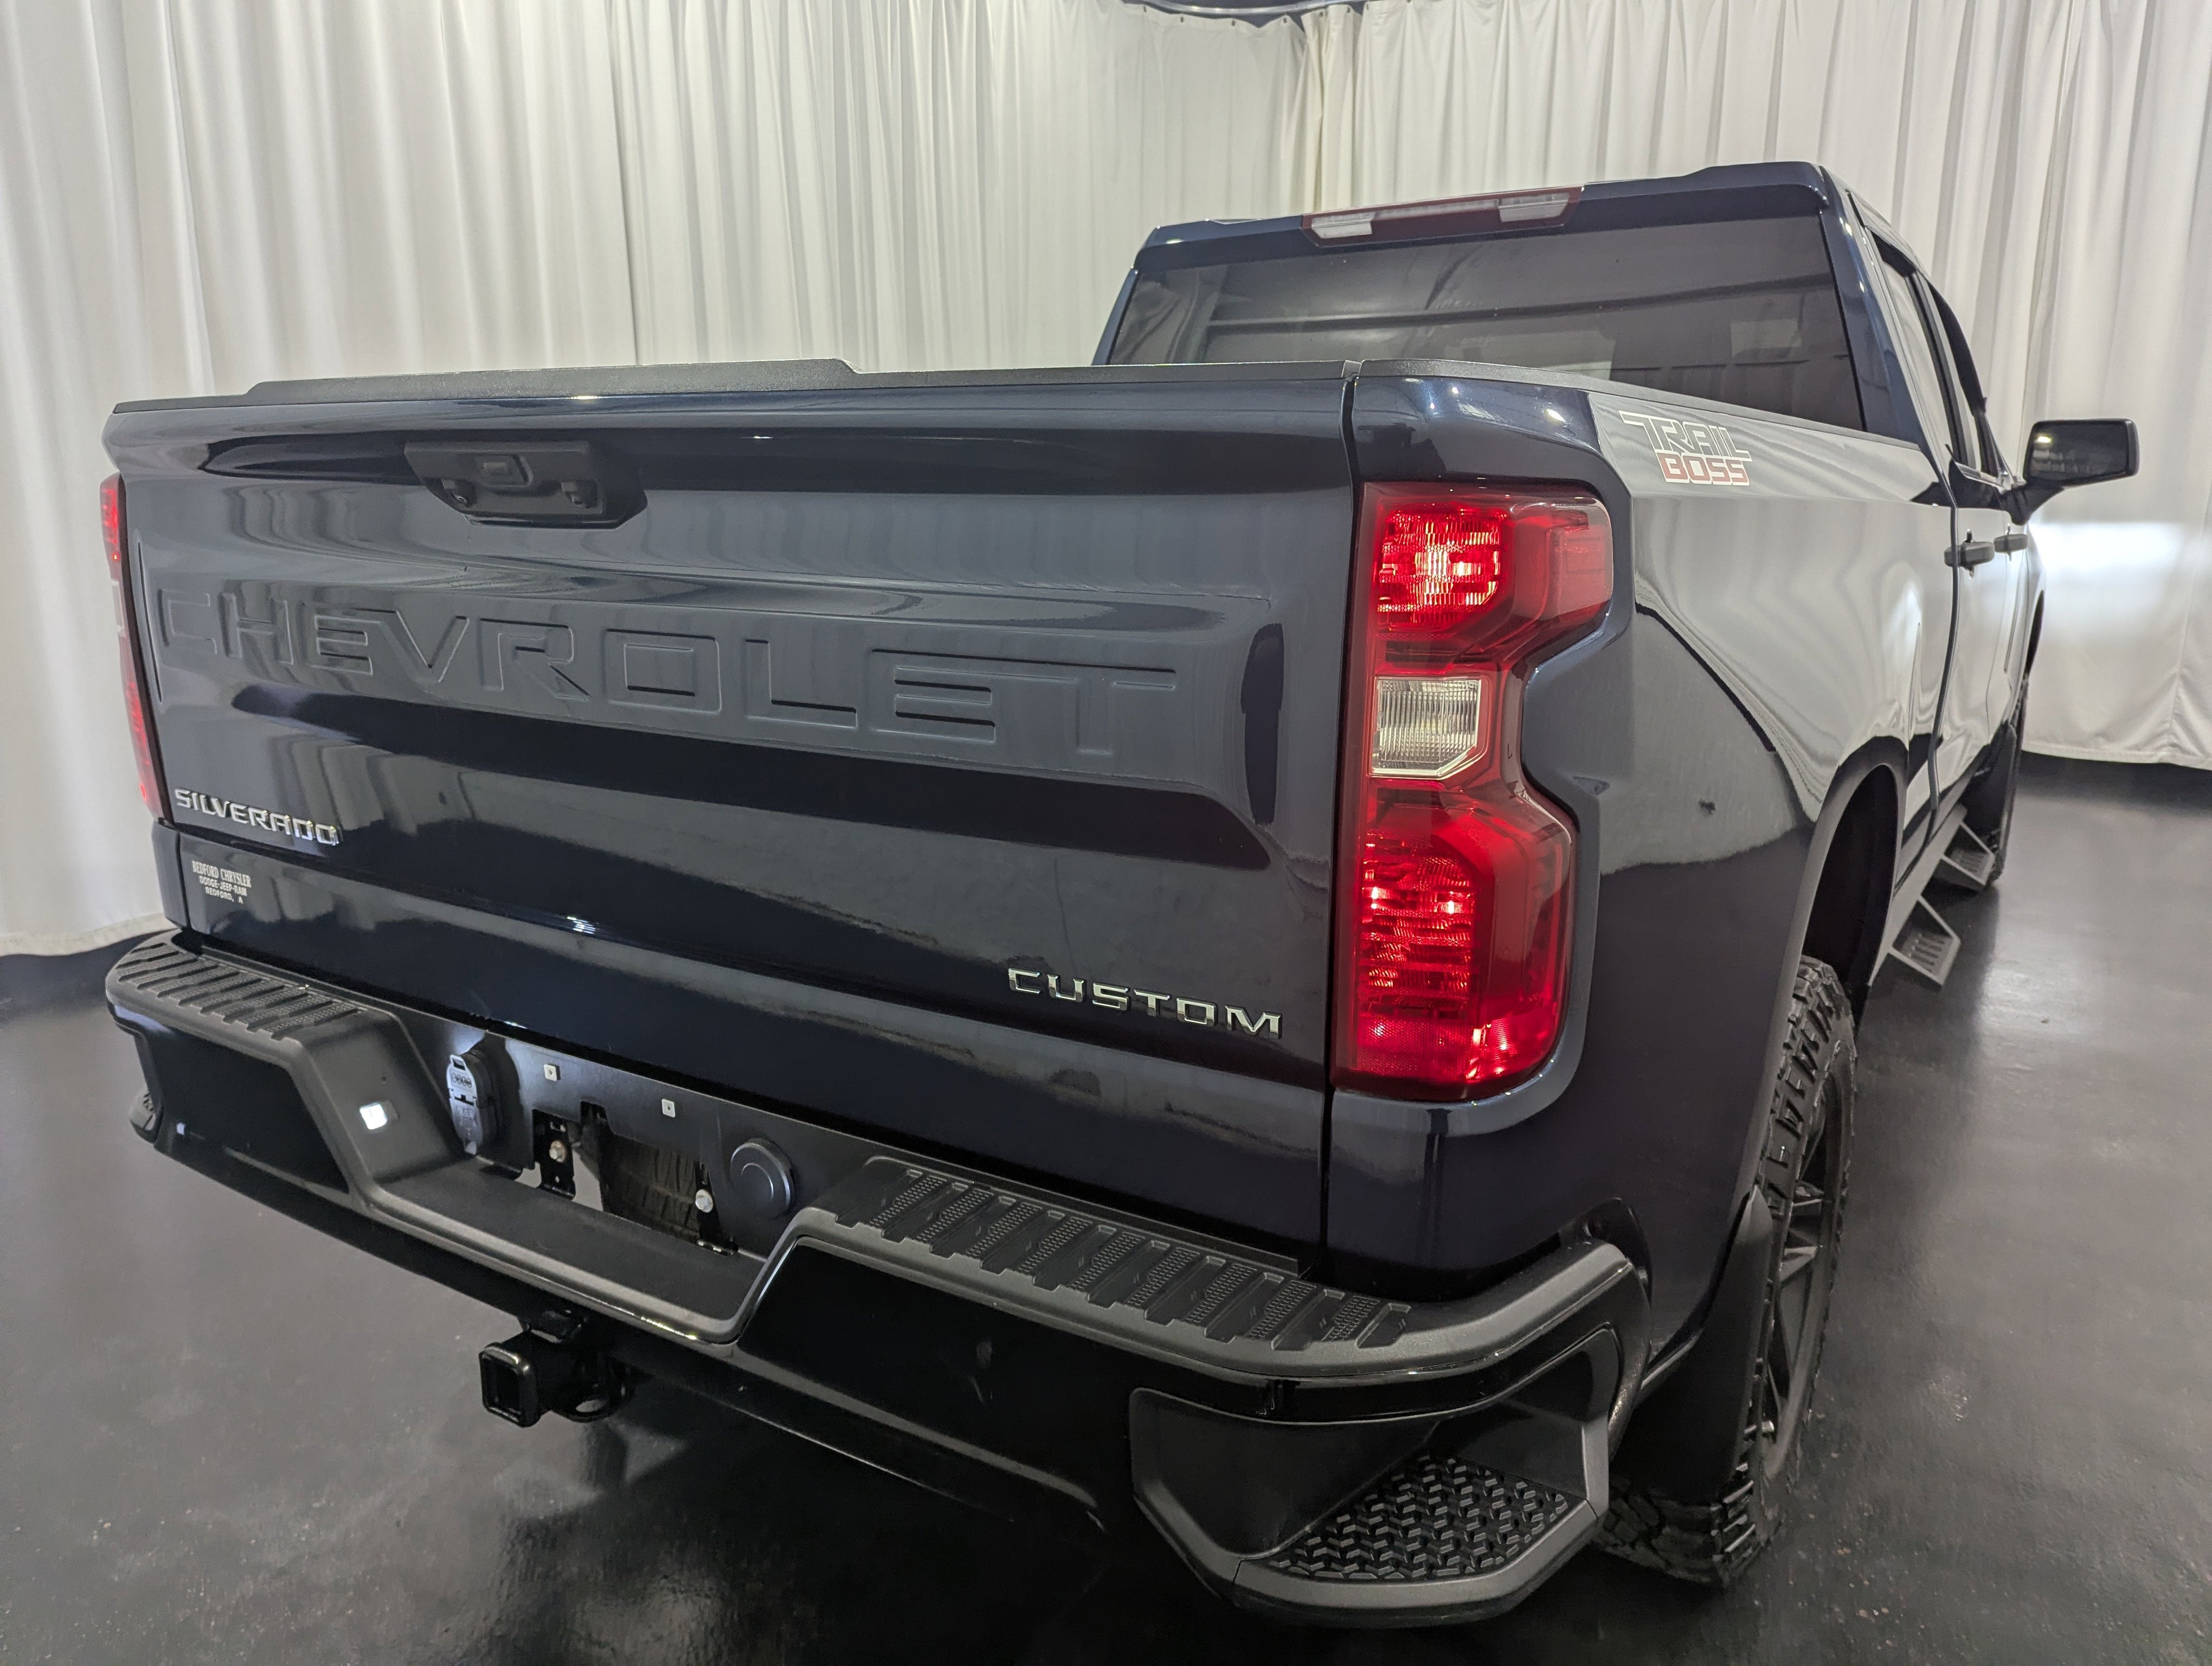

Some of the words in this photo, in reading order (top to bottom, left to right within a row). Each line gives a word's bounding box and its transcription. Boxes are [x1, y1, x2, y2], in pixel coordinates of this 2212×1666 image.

[1618, 410, 1753, 462] TRAIL
[1655, 448, 1750, 486] BOSS
[156, 588, 1176, 757] CHEVROLET
[174, 788, 342, 846] SILVERADO
[192, 860, 219, 879] BEDFORD
[220, 868, 252, 888] CHRYSLER
[1008, 967, 1282, 1040] CUSTOM
